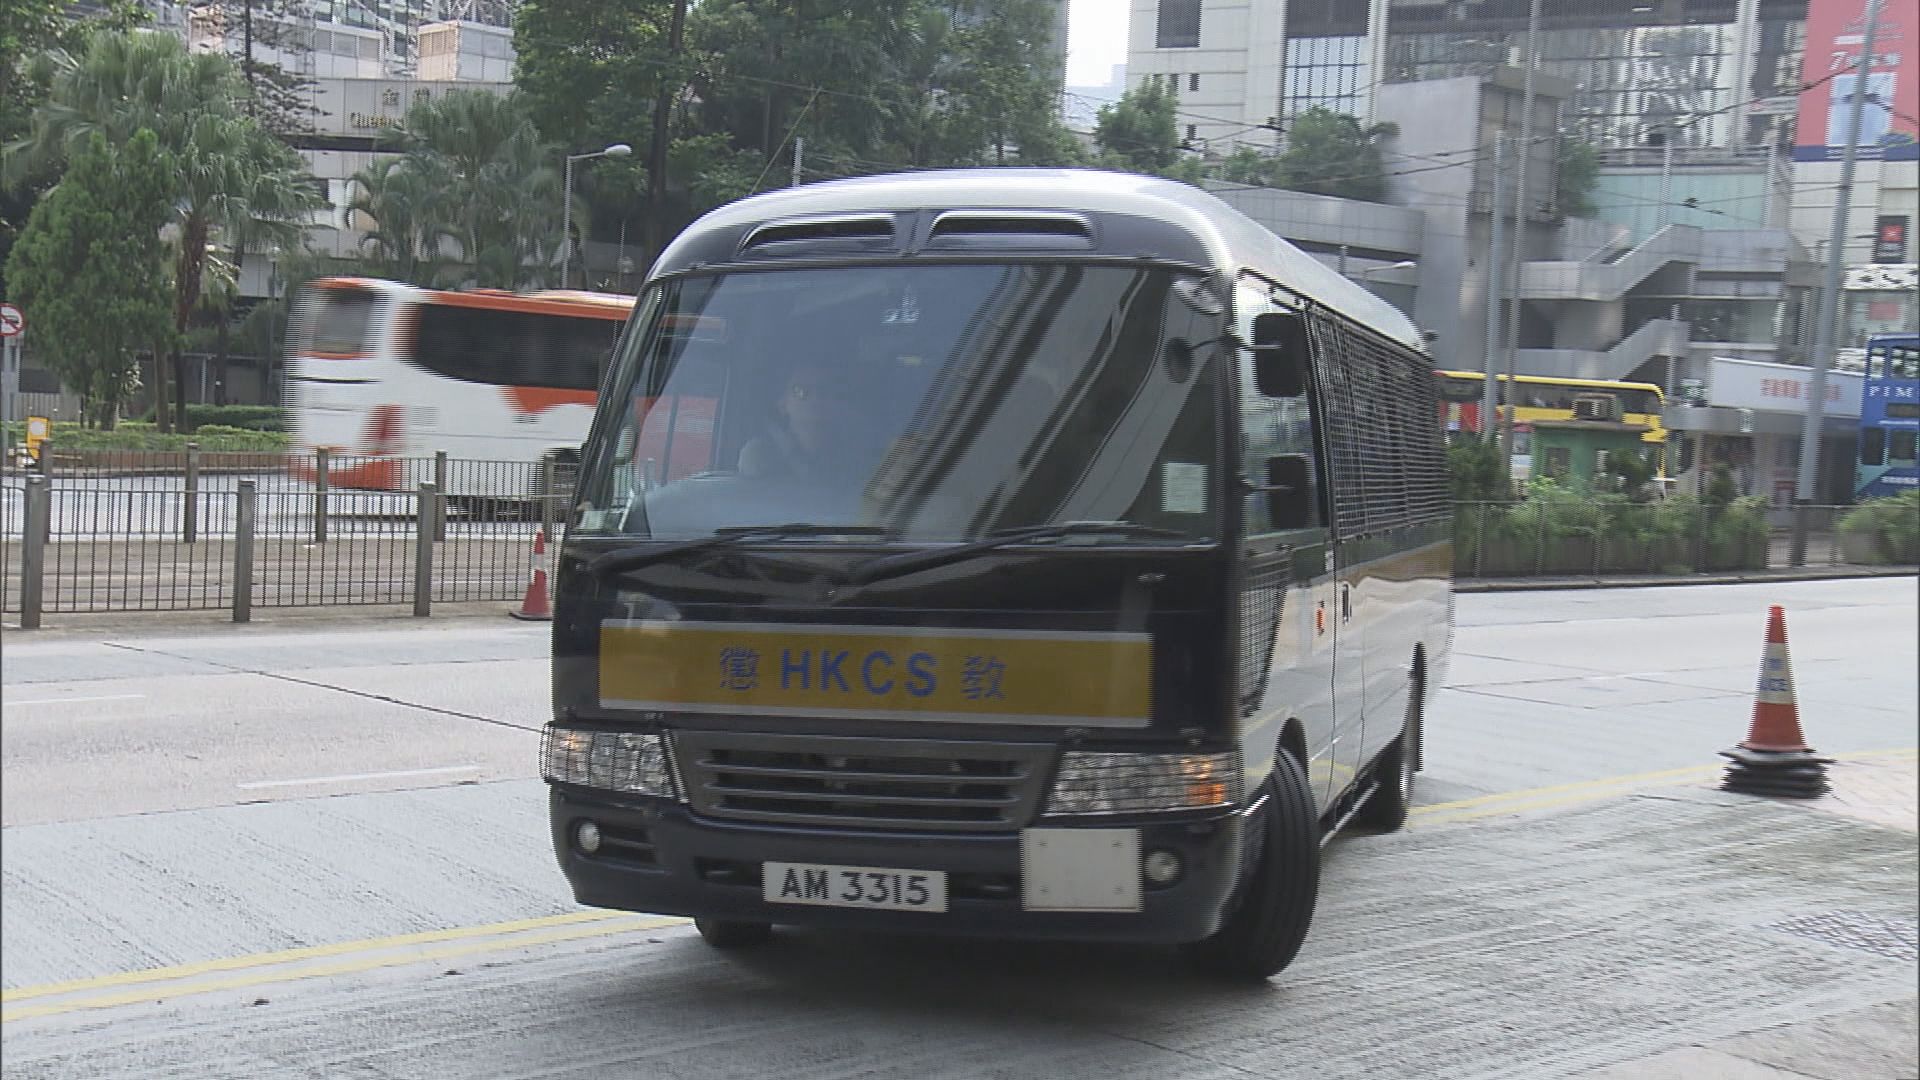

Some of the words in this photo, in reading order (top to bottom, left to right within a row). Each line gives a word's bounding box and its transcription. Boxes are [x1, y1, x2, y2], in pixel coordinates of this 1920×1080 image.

[1868, 385, 1918, 399] PIM
[779, 648, 939, 698] HKCS
[780, 867, 831, 900] AM
[839, 871, 931, 906] 3315
